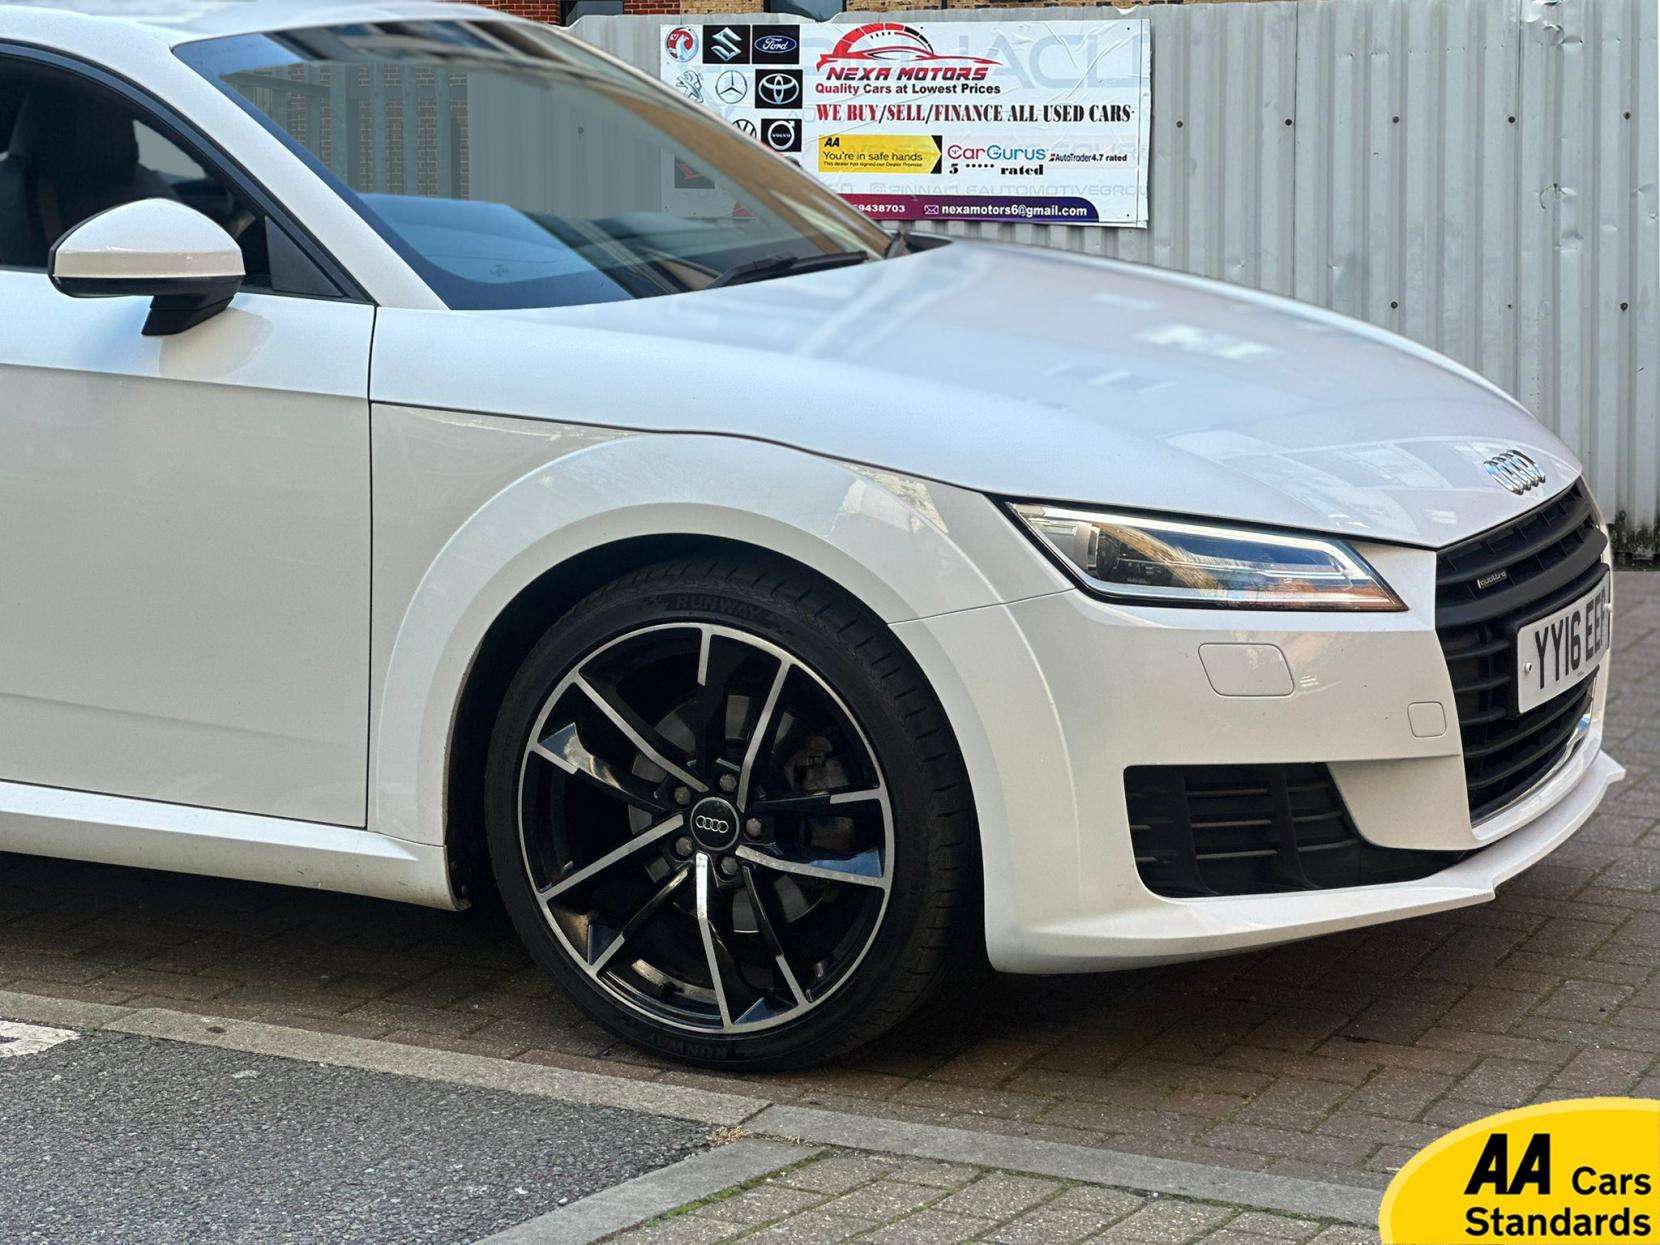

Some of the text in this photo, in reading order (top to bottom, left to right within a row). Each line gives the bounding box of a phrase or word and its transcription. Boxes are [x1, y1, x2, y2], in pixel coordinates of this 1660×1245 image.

[762, 38, 788, 50] Ford
[826, 67, 988, 81] NEXA MOTORS
[815, 83, 1001, 96] Quality Cars at Lowest Prices
[816, 104, 842, 121] WE
[846, 103, 1003, 124] BUY/SELL/FINANCE
[1008, 104, 1038, 122] ALL
[1043, 104, 1085, 122] USED
[1088, 104, 1131, 122] CARS
[824, 137, 840, 147] AA
[823, 151, 923, 161] You're in safe hands
[947, 144, 1046, 161] CarGurus
[949, 163, 1044, 175] 5 rated
[941, 204, 1088, 217] nexamotors6@gmail.com
[1534, 610, 1581, 689] YY16
